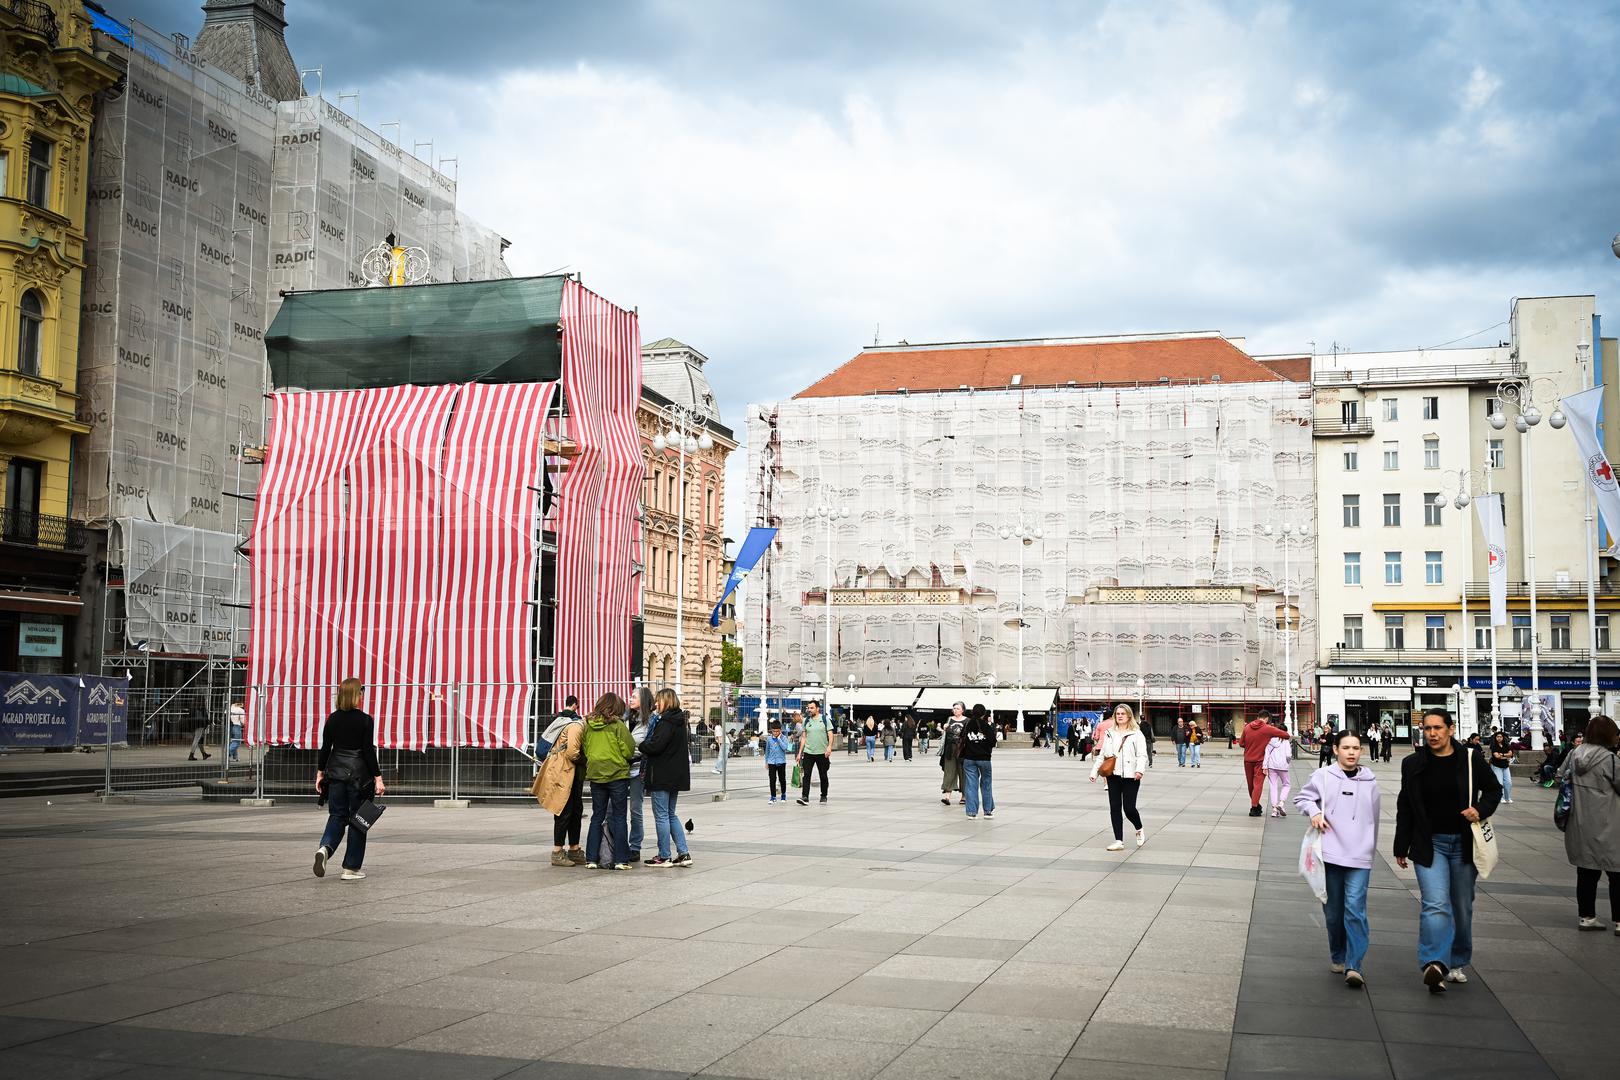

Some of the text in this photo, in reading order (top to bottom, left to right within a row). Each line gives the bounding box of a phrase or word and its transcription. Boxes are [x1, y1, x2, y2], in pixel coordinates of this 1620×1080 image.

[132, 82, 163, 108] RADIĆ
[208, 120, 238, 143] RADIĆ
[352, 158, 375, 180] RADIĆ
[166, 170, 198, 192] RADIĆ
[90, 187, 121, 200] ADIĆ
[404, 187, 425, 208] RADIĆ
[126, 212, 157, 237] RADIĆ
[239, 202, 267, 226] RADIĆ
[288, 210, 312, 242] R
[320, 219, 345, 242] RADIĆ
[200, 243, 232, 266] RADIĆ
[275, 248, 315, 264] RADIĆ
[82, 301, 112, 314] ADIĆ
[162, 300, 192, 322] RADIĆ
[128, 304, 146, 342] R
[234, 322, 262, 341] RADIĆ
[119, 347, 150, 368] RADIĆ
[206, 328, 222, 366] R
[197, 369, 226, 390] RADIĆ
[165, 388, 184, 426] R
[156, 430, 186, 452] RADIĆ
[116, 482, 145, 499] RADIĆ
[190, 496, 220, 514] RADIĆ
[130, 581, 160, 596] RADIĆ
[166, 610, 197, 624] RADIĆ
[1346, 676, 1407, 685] MARTIMEX
[2, 712, 66, 726] AGRAD PROJEKT d.o.o.
